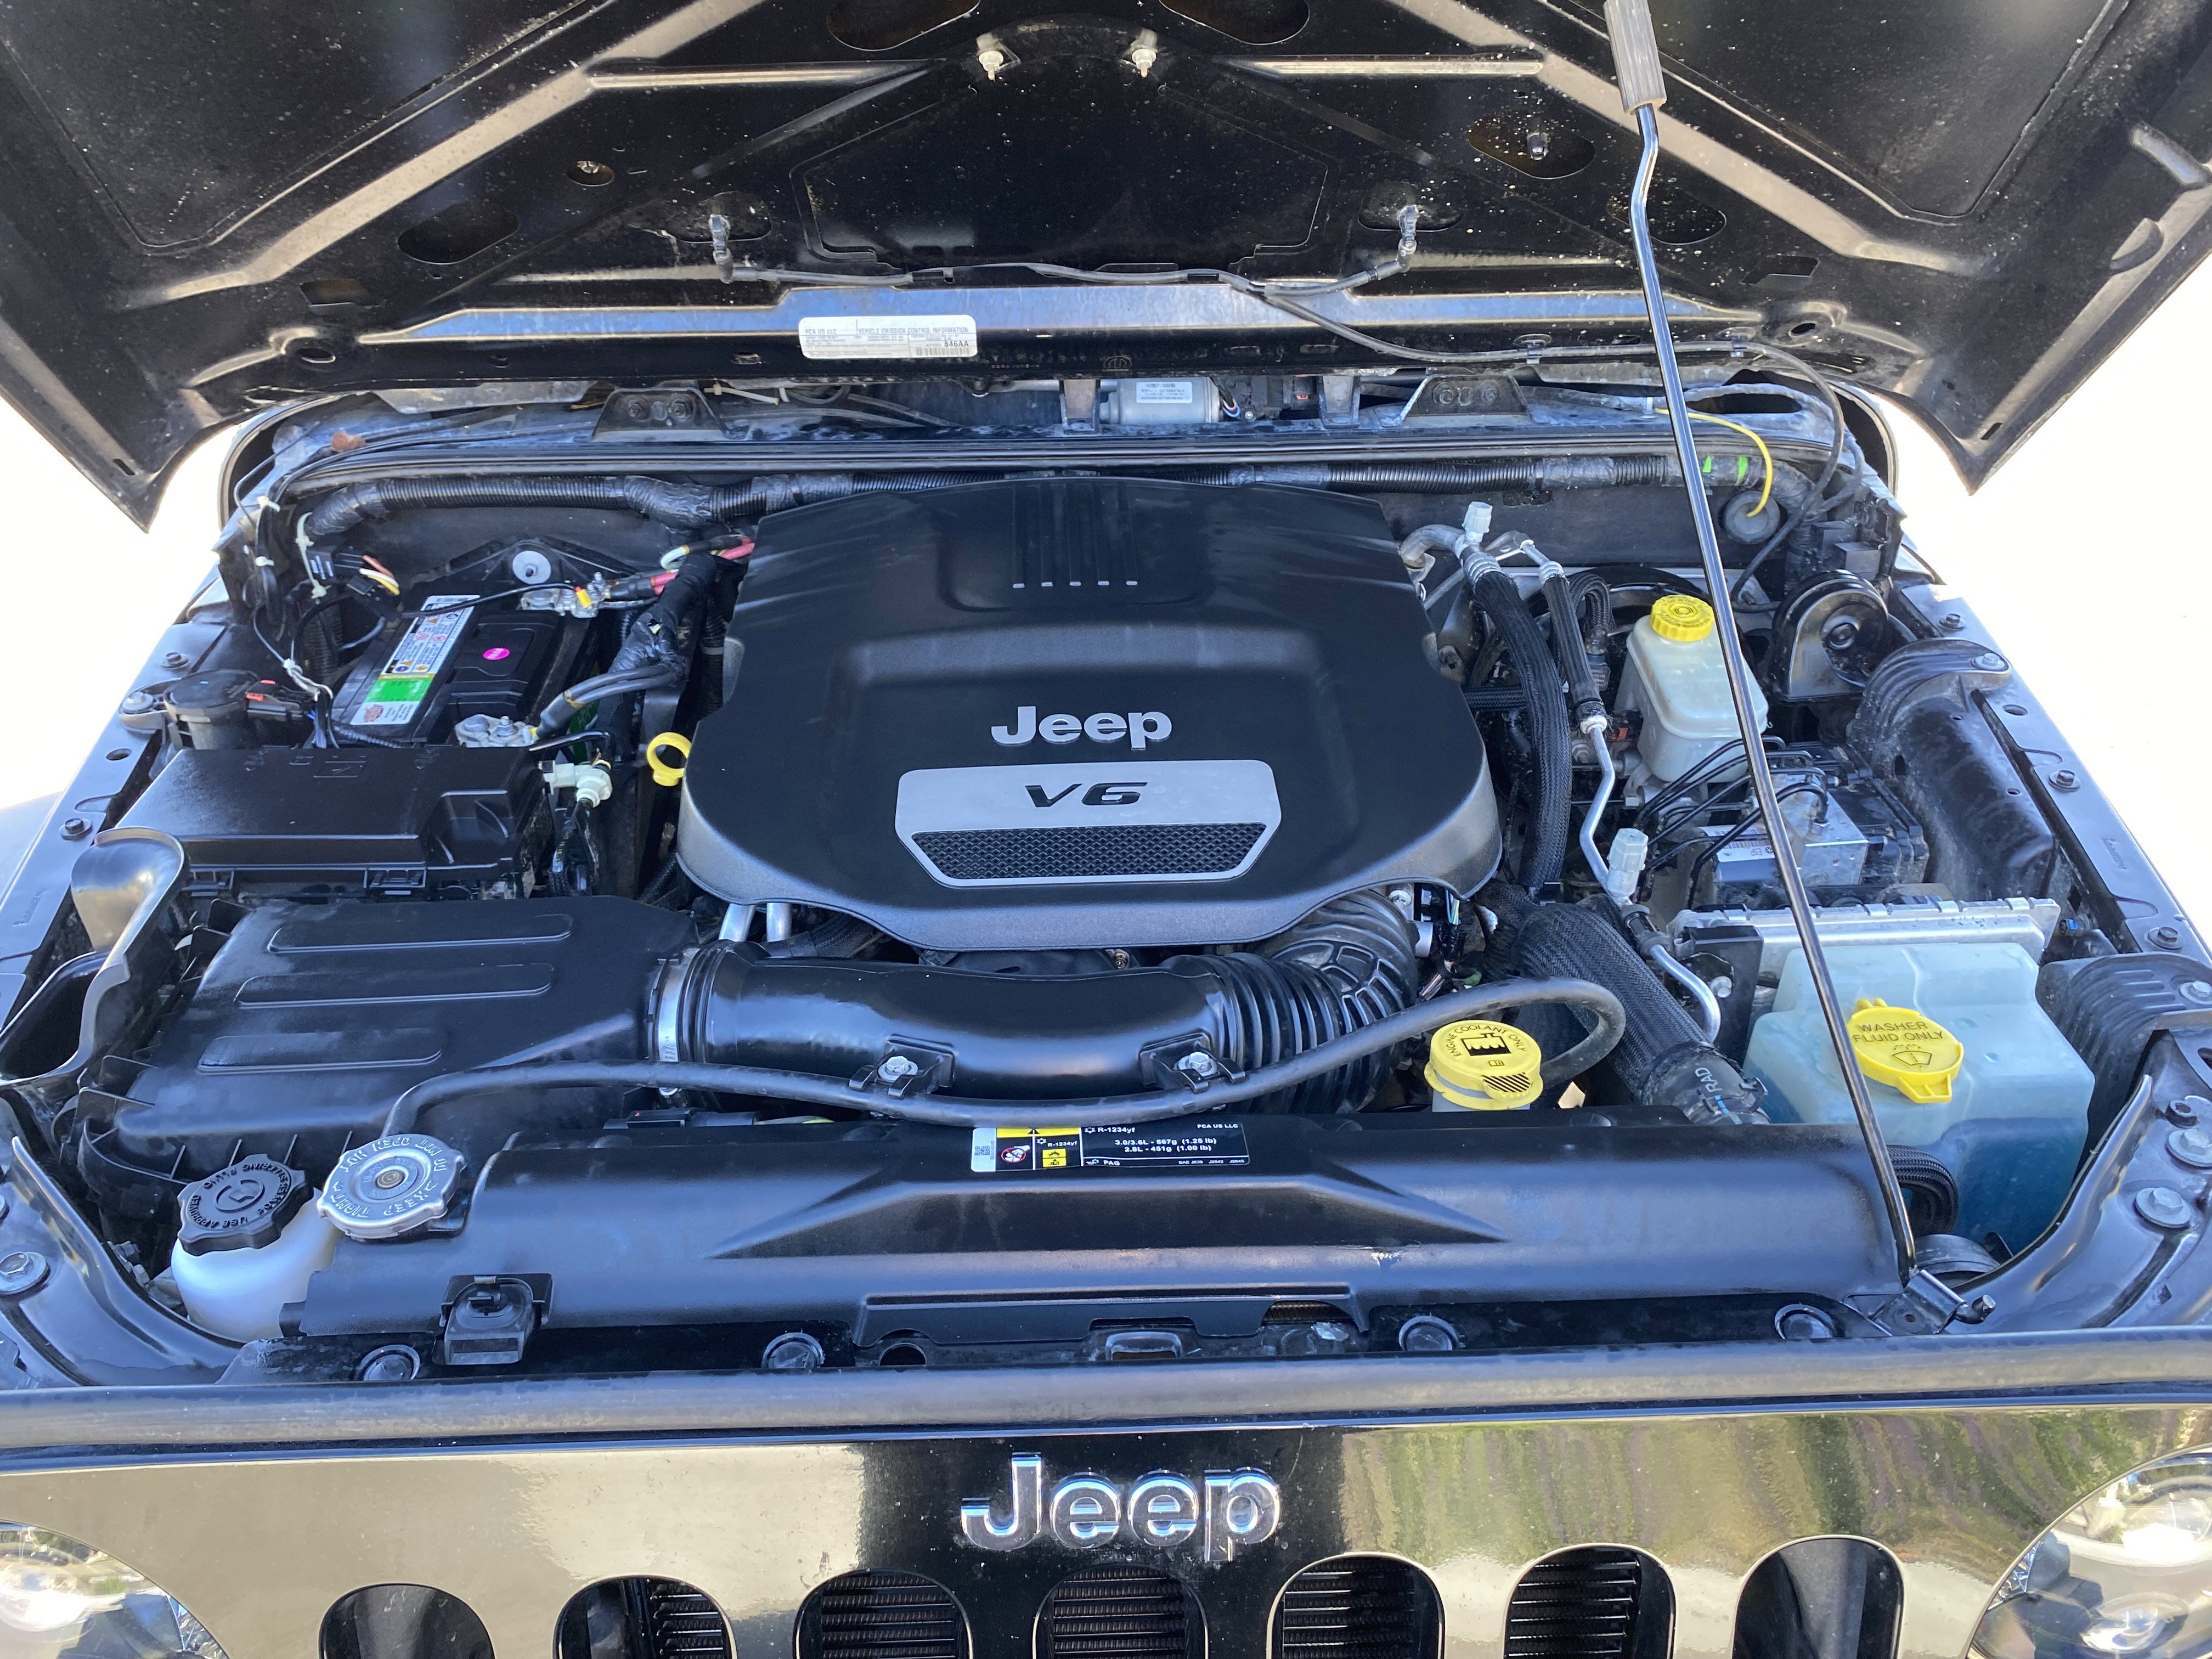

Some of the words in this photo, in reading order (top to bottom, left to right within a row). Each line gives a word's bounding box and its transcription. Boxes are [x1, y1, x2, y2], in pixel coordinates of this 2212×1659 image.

[991, 706, 1172, 750] Jeep
[1025, 782, 1148, 807] V6
[1852, 1033, 1899, 1042] FLUID
[1904, 1031, 1944, 1041] ONLY
[1857, 1022, 1928, 1031] WASHER
[1446, 1033, 1462, 1057] ENGINE
[1454, 1025, 1508, 1034] COOLANT
[1509, 1034, 1527, 1052] ONLY
[1695, 1068, 1722, 1092] RAD
[371, 1137, 410, 1152] OPEN
[189, 1194, 219, 1229] APPROVED
[961, 1452, 1280, 1562] Jeep
